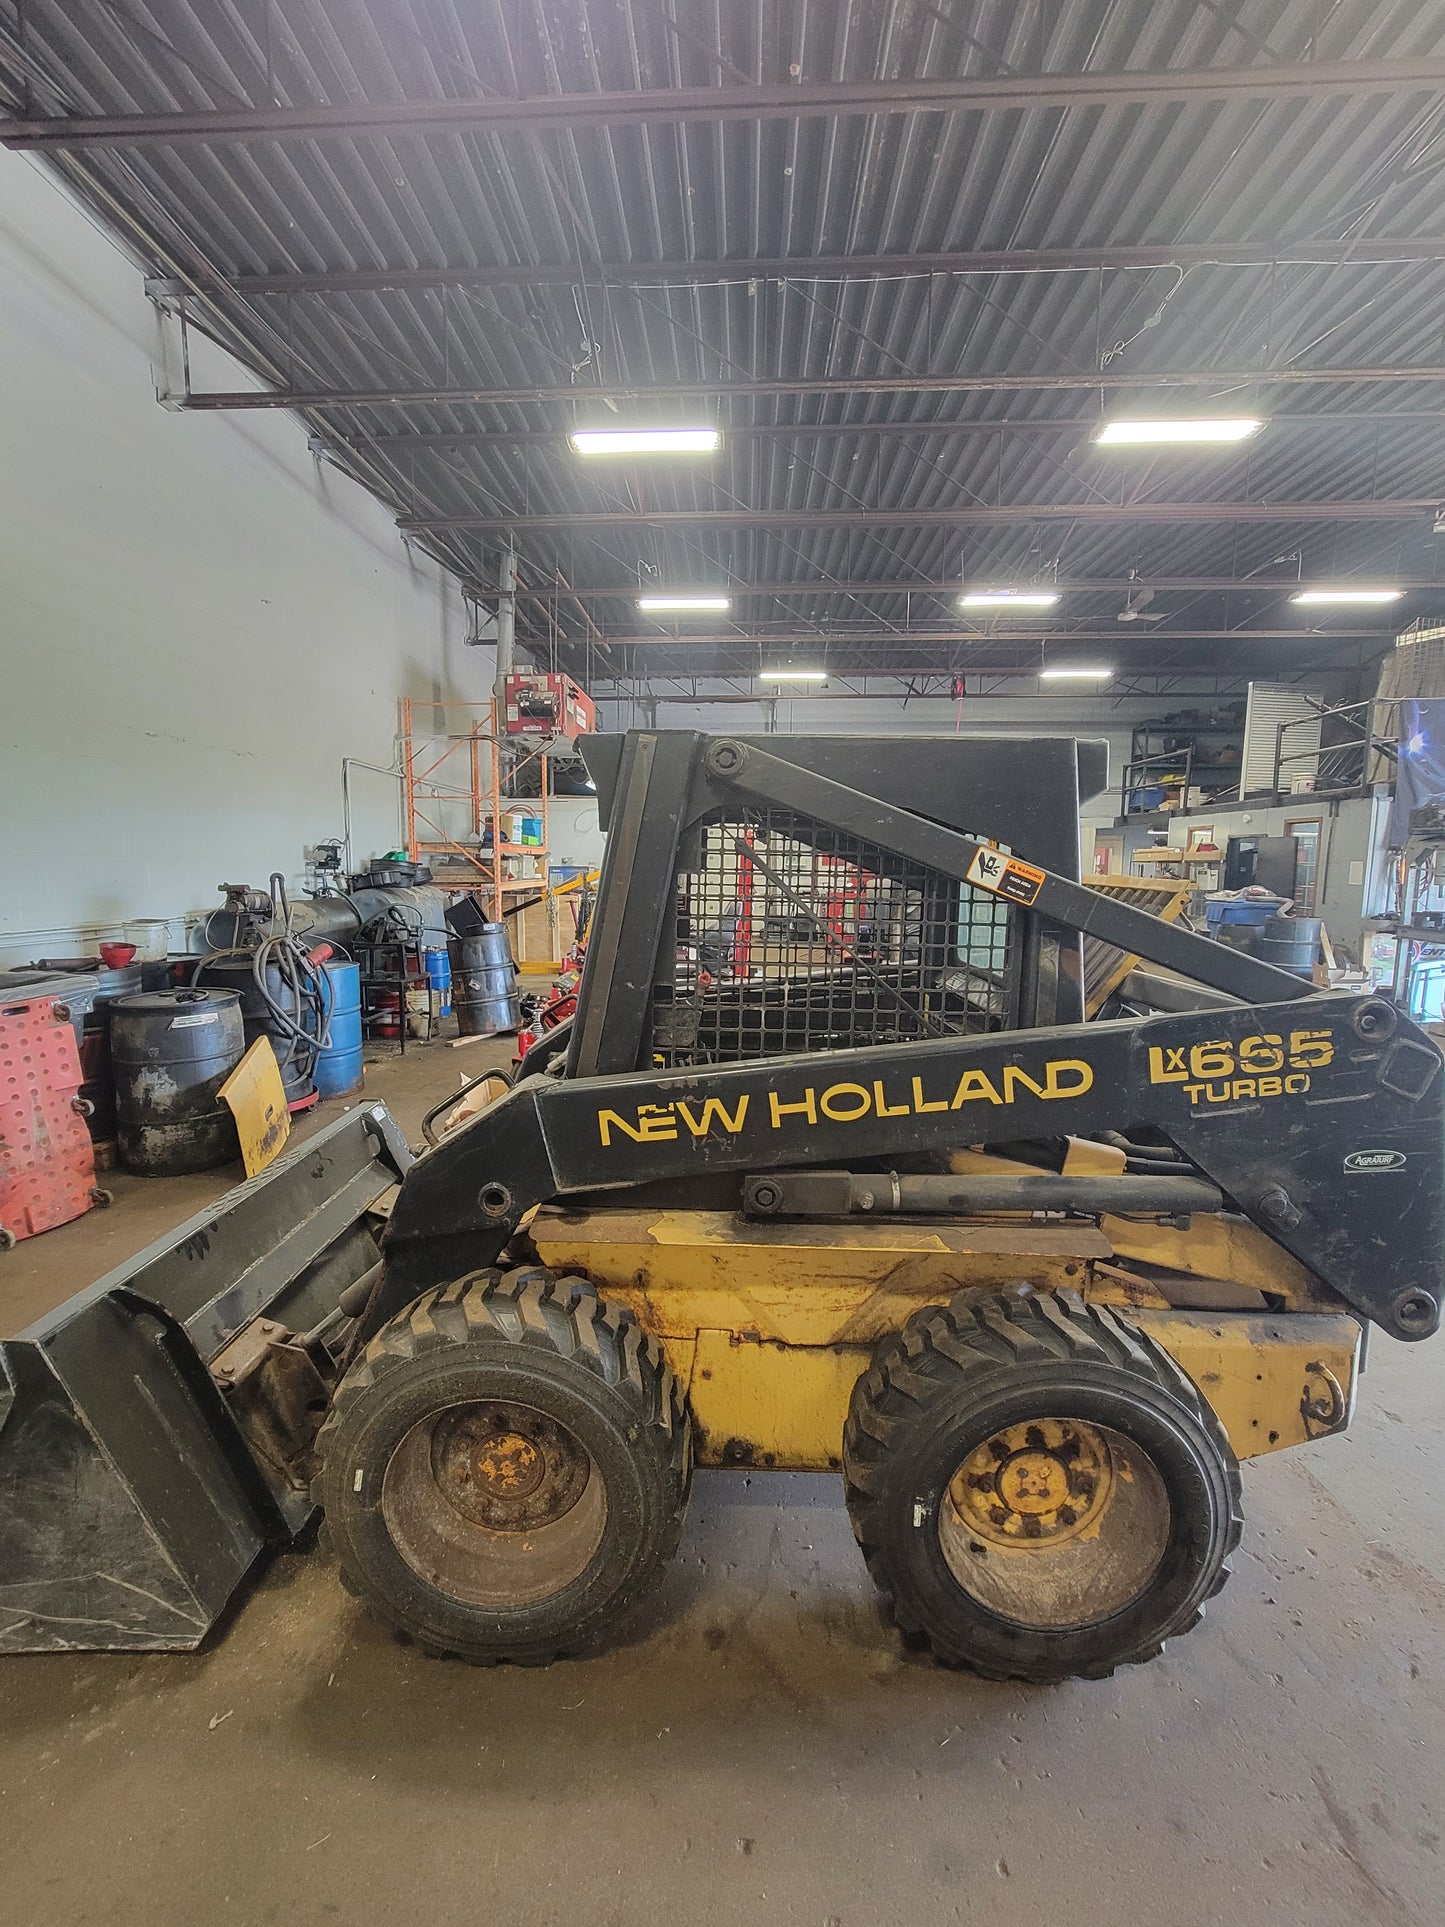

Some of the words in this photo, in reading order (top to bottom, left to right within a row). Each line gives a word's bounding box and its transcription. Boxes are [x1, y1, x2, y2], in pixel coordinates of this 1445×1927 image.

[1017, 866, 1042, 880] WARNING
[1183, 1073, 1311, 1104] TURBO
[598, 1095, 749, 1146] NEW
[769, 1059, 1094, 1128] HOLLAND
[1354, 1154, 1395, 1166] AGRATURF
